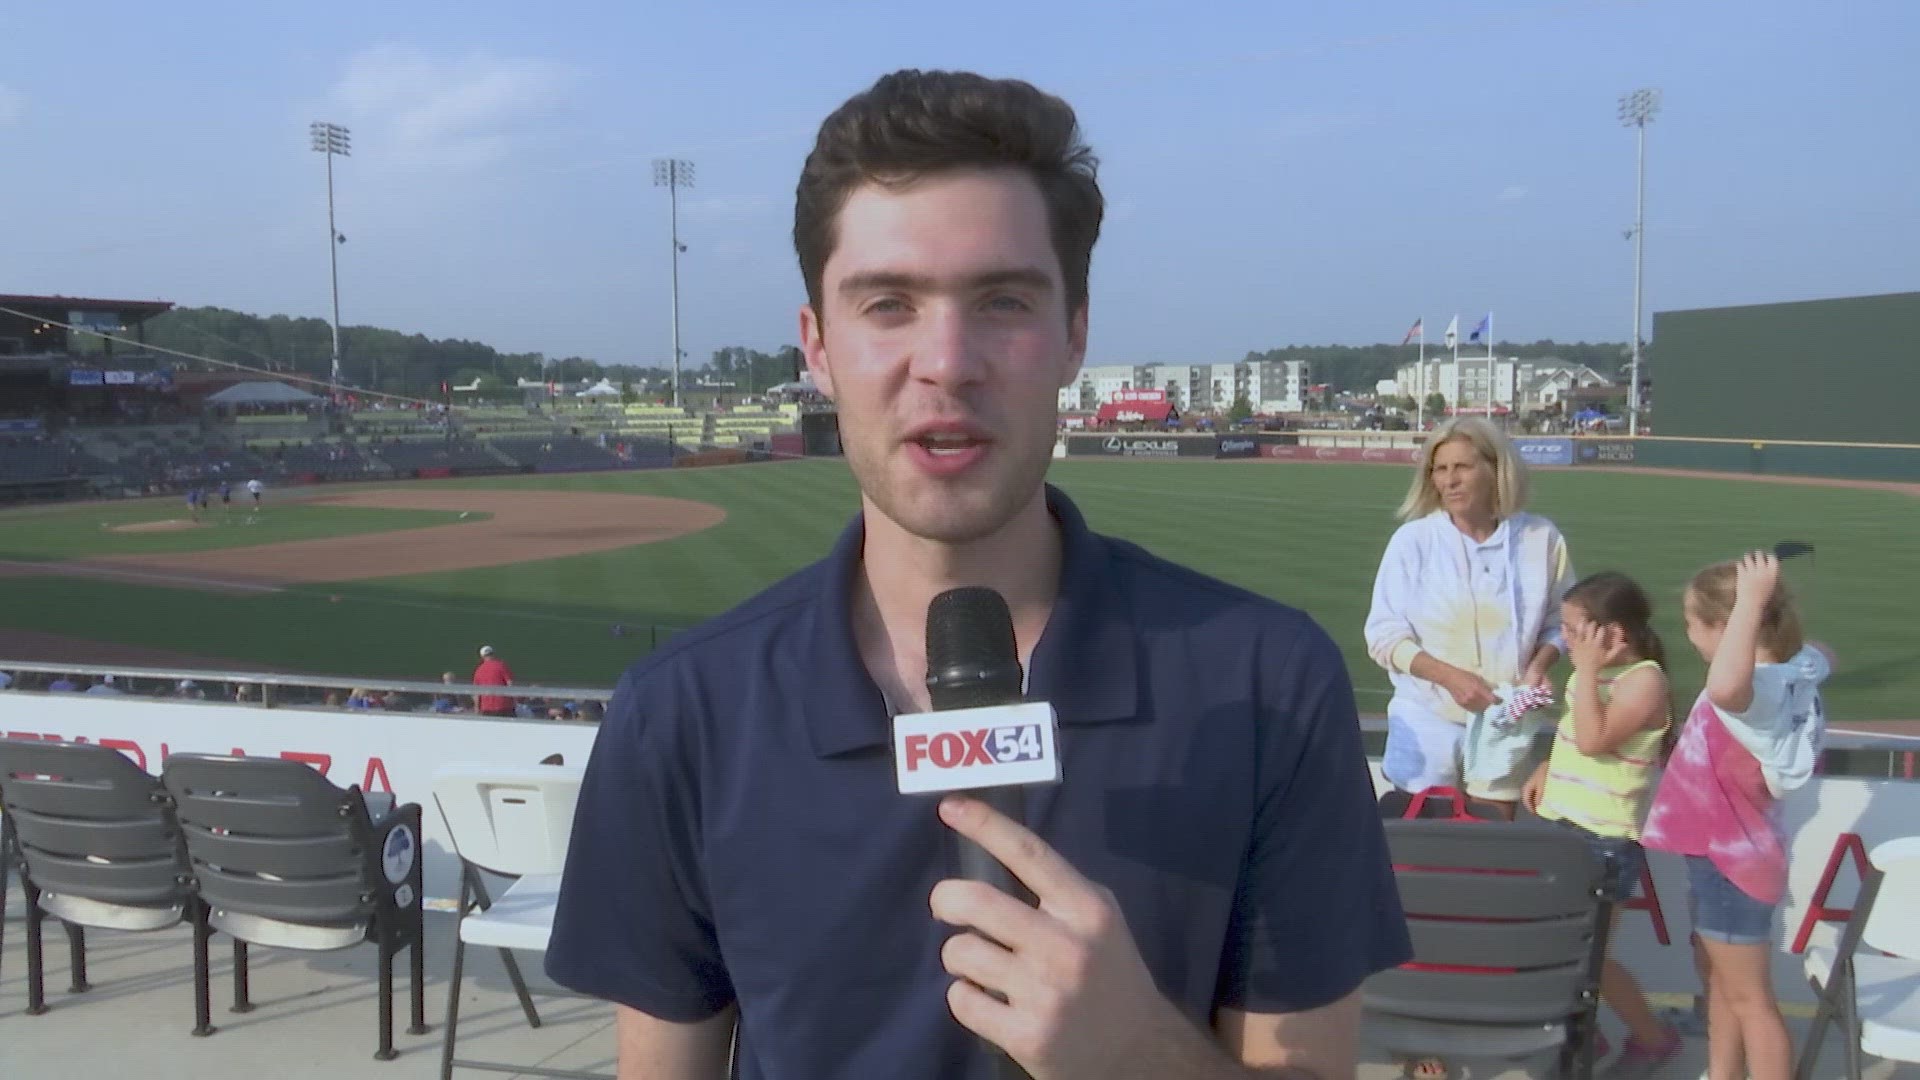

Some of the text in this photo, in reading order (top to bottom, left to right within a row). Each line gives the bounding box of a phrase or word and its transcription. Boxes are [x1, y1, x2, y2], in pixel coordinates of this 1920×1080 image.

[1124, 441, 1178, 450] LEXUS
[1598, 444, 1634, 452] WORLD
[905, 726, 1041, 771] FOX 54
